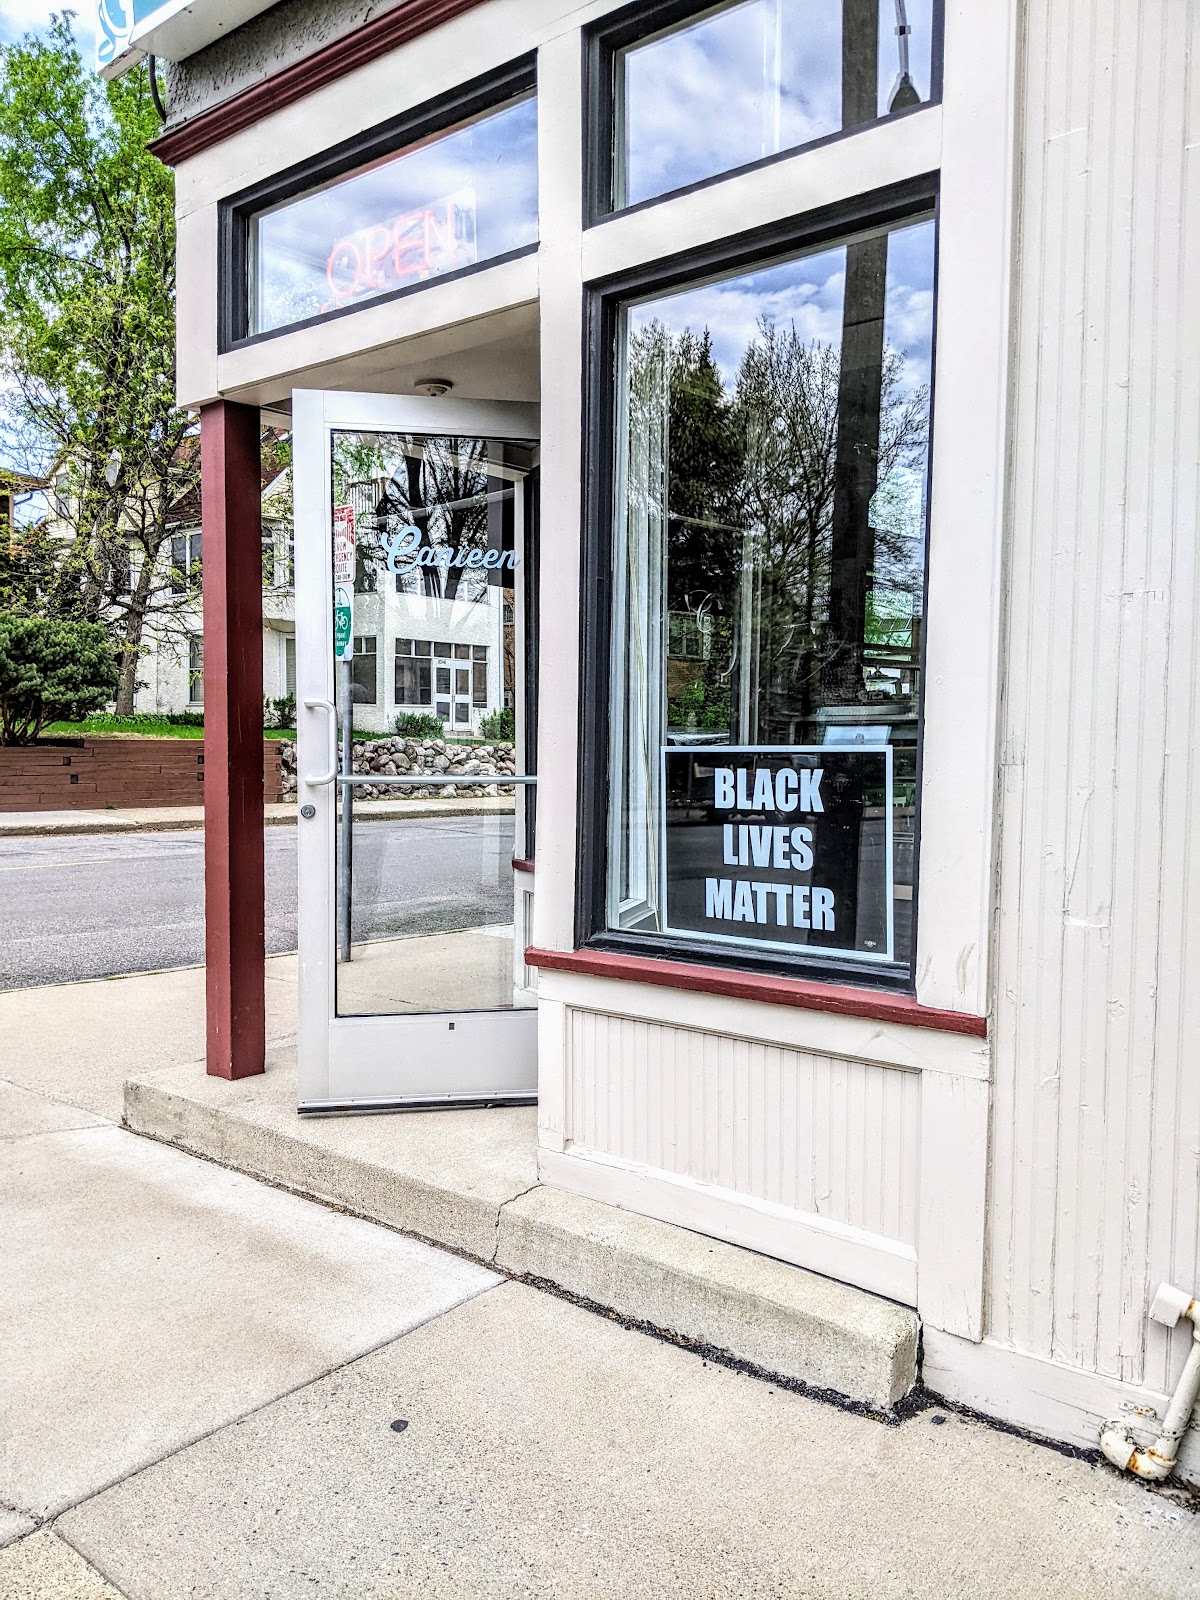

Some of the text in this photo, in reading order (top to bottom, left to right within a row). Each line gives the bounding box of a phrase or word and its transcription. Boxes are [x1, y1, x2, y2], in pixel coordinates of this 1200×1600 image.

[327, 200, 457, 297] OPEN
[381, 525, 520, 574] Canteen
[714, 768, 825, 813] BLACK
[723, 824, 814, 871] LIVES
[705, 878, 836, 932] MATTER
